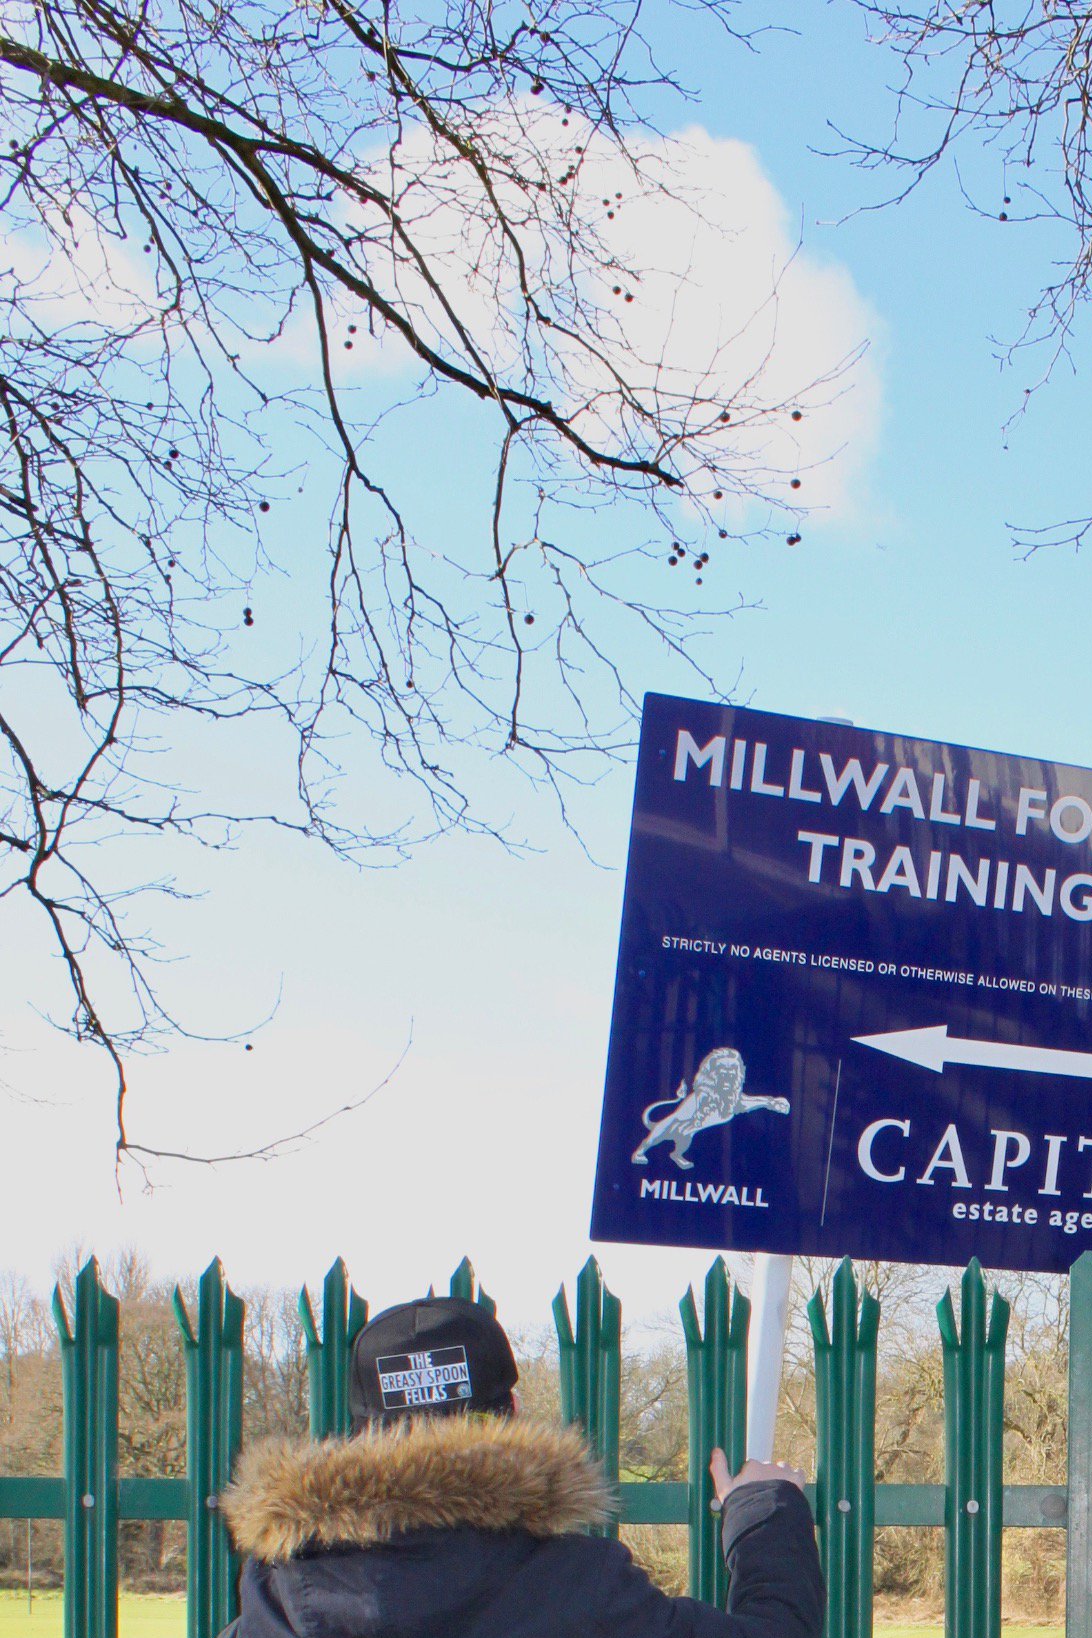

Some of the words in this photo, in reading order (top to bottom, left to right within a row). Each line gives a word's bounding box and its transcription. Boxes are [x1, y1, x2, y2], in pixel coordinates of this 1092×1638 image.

[674, 729, 996, 830] MILLWALL
[662, 936, 726, 955] STRICTLY
[731, 944, 750, 958] NO
[753, 947, 806, 965] AGENTS
[810, 954, 874, 973] LICENSED
[878, 962, 896, 975] OR
[900, 966, 974, 985] OTHERWISE
[977, 975, 1035, 993] ALLOWED
[1039, 982, 1057, 996] ON
[641, 1178, 769, 1208] MILLWALL
[952, 1201, 1038, 1227] estate
[408, 1352, 433, 1369] THE
[381, 1372, 423, 1391] GREASY
[427, 1365, 467, 1383] SPOON
[404, 1386, 447, 1405] FELLAS
